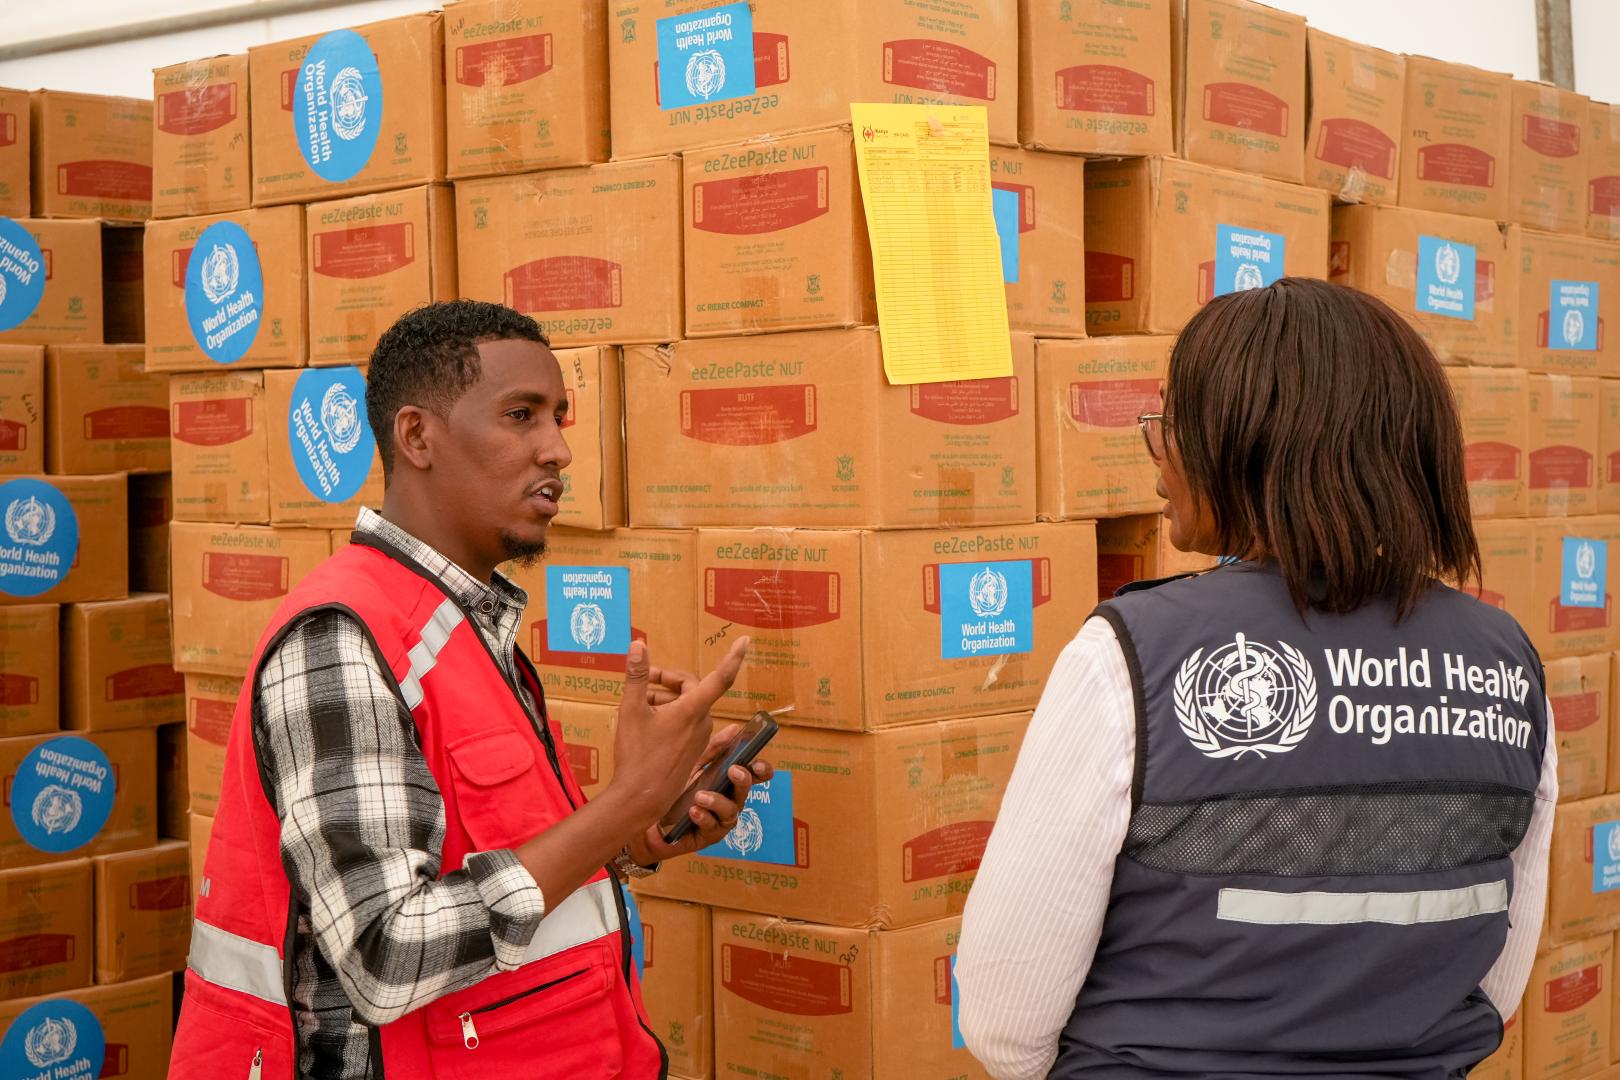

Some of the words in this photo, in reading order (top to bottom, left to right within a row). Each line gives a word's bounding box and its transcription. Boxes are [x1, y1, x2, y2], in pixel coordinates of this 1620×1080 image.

[526, 16, 544, 29] NUT
[674, 13, 733, 35] Organization
[676, 33, 700, 50] Health
[702, 27, 733, 47] World
[315, 60, 328, 110] World
[307, 64, 320, 164] Organization
[696, 94, 779, 123] eeZeePaste
[669, 112, 691, 127] NUT
[1093, 117, 1148, 136] eeZeePaste
[321, 116, 334, 162] Health
[704, 147, 787, 173] eeZeePaste
[793, 145, 816, 161] NUT
[1003, 161, 1023, 176] NUT
[321, 204, 382, 225] eeZeePaste
[385, 203, 404, 217] NUT
[0, 235, 39, 274] Organiz
[0, 257, 32, 287] World
[202, 307, 227, 334] World
[227, 290, 254, 317] Health
[696, 304, 706, 312] GC
[708, 301, 730, 311] RIEBER
[731, 299, 764, 310] COMPACT
[206, 308, 258, 350] Organization
[691, 360, 774, 381] eeZeePaste
[779, 361, 804, 376] NUT
[1078, 360, 1138, 375] eeZeePaste
[292, 408, 333, 497] Organization
[300, 397, 321, 441] World
[317, 440, 341, 488] Health
[211, 533, 264, 549] eeZeePaste
[934, 536, 1014, 554] eeZeePaste
[1019, 536, 1039, 551] NUT
[0, 546, 23, 562] orld
[25, 549, 60, 567] Health
[716, 543, 799, 561] eeZeePaste
[804, 548, 828, 562] NUT
[0, 562, 58, 580] rganization
[562, 570, 612, 586] Organization
[563, 586, 588, 600] Health
[589, 587, 612, 600] World
[962, 622, 986, 636] World
[989, 619, 1015, 634] Health
[962, 635, 1015, 653] Organization
[543, 673, 561, 684] NUT
[1324, 647, 1431, 688] World
[1443, 653, 1530, 705] Health
[565, 676, 625, 697] ZeePaste
[885, 692, 895, 701] GC
[1328, 695, 1532, 749] Organization
[574, 728, 592, 740] NUT
[36, 762, 70, 783] Health
[40, 748, 107, 780] Organization
[71, 774, 103, 794] World
[687, 861, 709, 876] NUT
[713, 864, 798, 889] eeZeePaste
[912, 887, 932, 901] NUT
[937, 878, 974, 897] ePaste
[732, 922, 809, 950] eeZeePaste
[814, 938, 838, 955] NUT
[54, 1057, 91, 1078] Health
